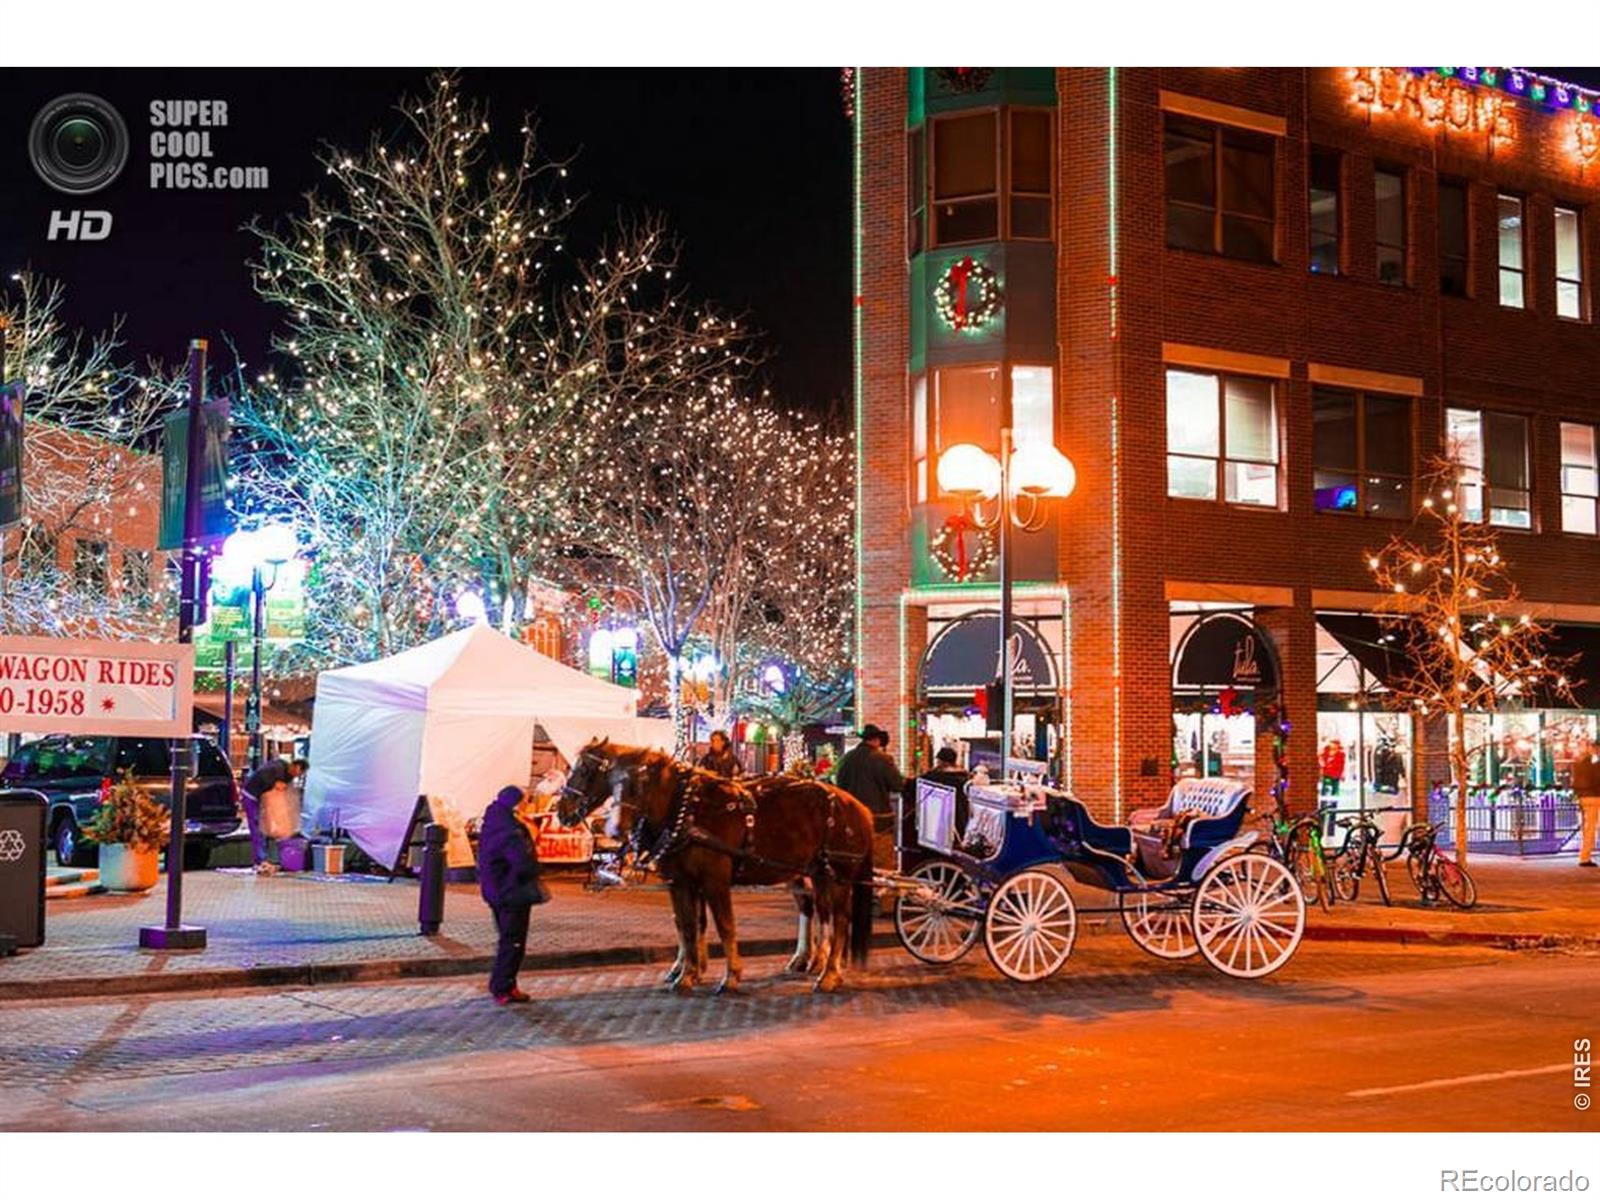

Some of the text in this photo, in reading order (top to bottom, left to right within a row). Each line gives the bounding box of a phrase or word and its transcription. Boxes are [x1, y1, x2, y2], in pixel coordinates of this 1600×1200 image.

[0, 655, 175, 687] WAGON RIDES
[0, 687, 85, 715] 0-1958
